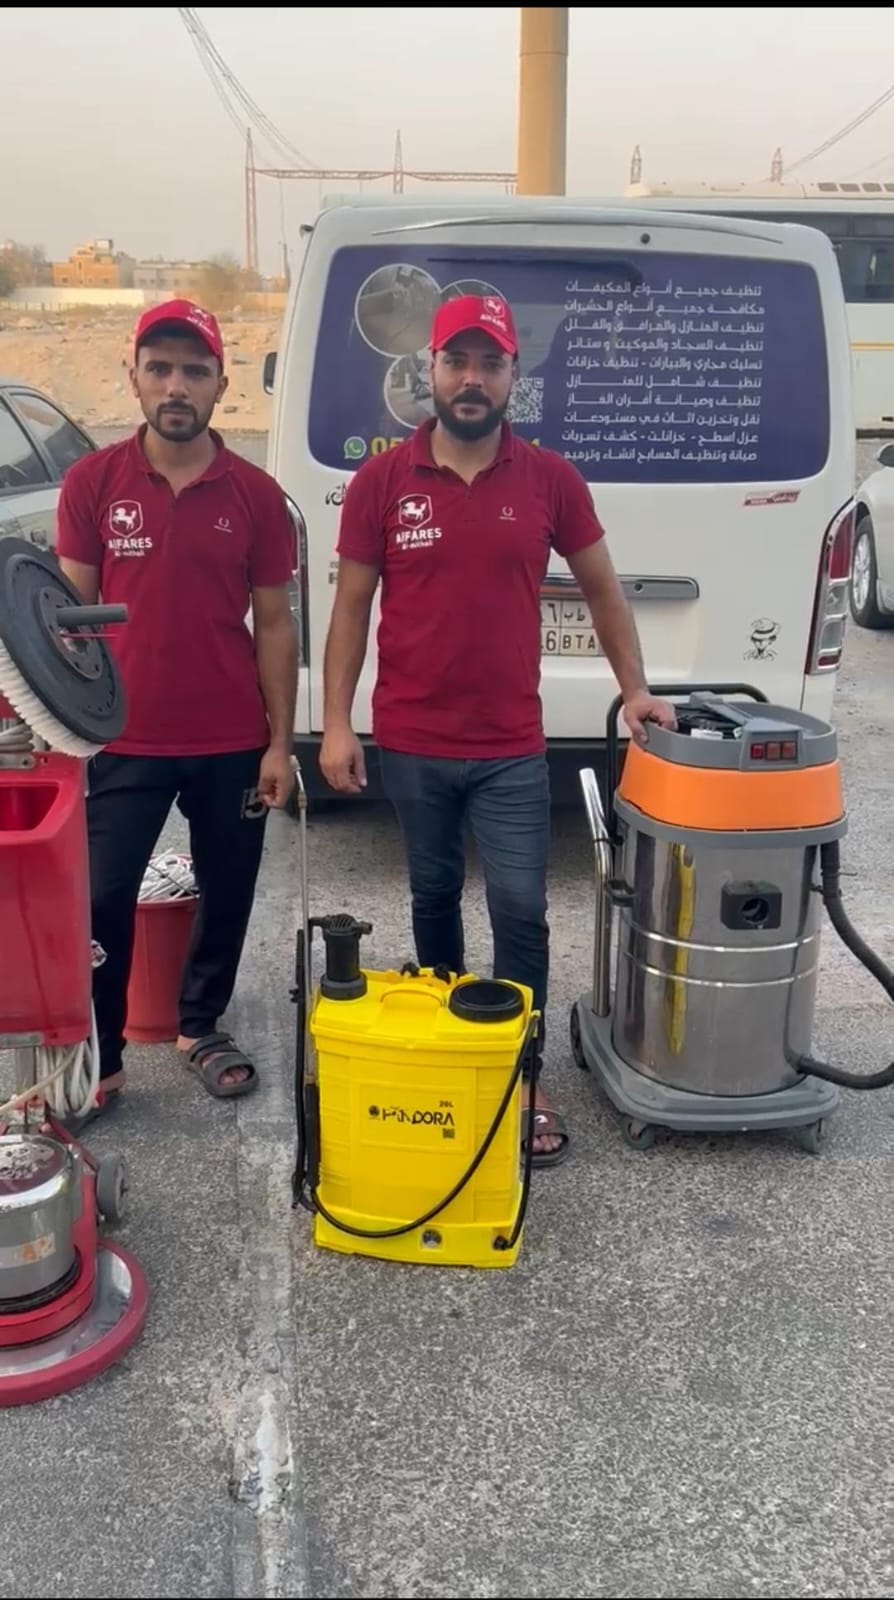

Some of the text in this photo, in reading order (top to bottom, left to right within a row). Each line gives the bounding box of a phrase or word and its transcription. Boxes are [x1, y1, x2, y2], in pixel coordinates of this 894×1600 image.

[566, 280, 761, 299] تنظيف جميع أنواع المكيفات
[564, 298, 764, 317] مكافحة جميع أنواع الحشرات
[564, 318, 612, 332] والفلل
[679, 320, 718, 334] المنازل
[721, 321, 764, 334] تنظيف
[616, 338, 668, 352] والموكيت
[672, 338, 713, 351] السجاد
[715, 339, 763, 352] تنظيف
[566, 356, 600, 369] خزانات
[603, 356, 638, 370] تنظيف
[694, 356, 726, 371] مجاري
[729, 357, 762, 370] تسليك
[566, 375, 761, 389] تنظيف شامل للمنازل
[616, 391, 652, 407] أفران
[655, 394, 714, 408] وصيانة
[716, 394, 760, 408] تنظيف
[564, 412, 637, 425] مستودعات
[638, 412, 659, 425] في
[697, 412, 738, 426] وتخزين
[741, 412, 760, 426] نقل
[603, 430, 638, 442] كشف
[737, 431, 758, 444] عزل
[637, 447, 679, 464] المسابح
[681, 448, 726, 462] وتنظيف
